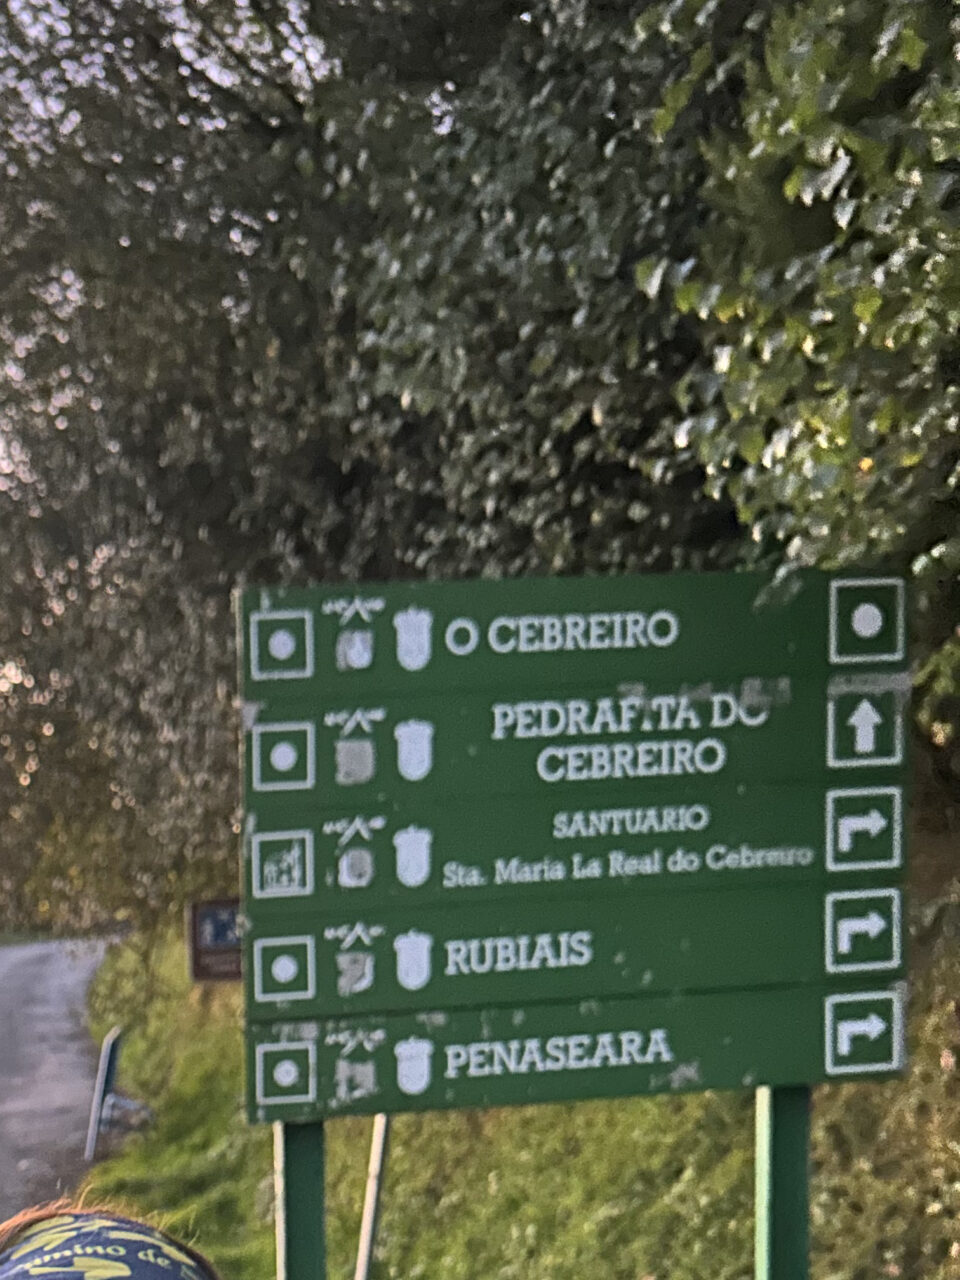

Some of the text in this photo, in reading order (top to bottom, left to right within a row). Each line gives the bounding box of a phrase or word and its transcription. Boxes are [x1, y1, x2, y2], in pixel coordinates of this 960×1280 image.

[445, 609, 679, 656] O CEBREIRO
[536, 738, 727, 782] CEBREIRO
[552, 804, 709, 839] SANTUARIO
[443, 860, 486, 888] Sta.
[572, 852, 602, 880] La
[608, 848, 663, 877] Real
[444, 930, 594, 976] RUBIAIS
[444, 1028, 674, 1080] PENASEARA
